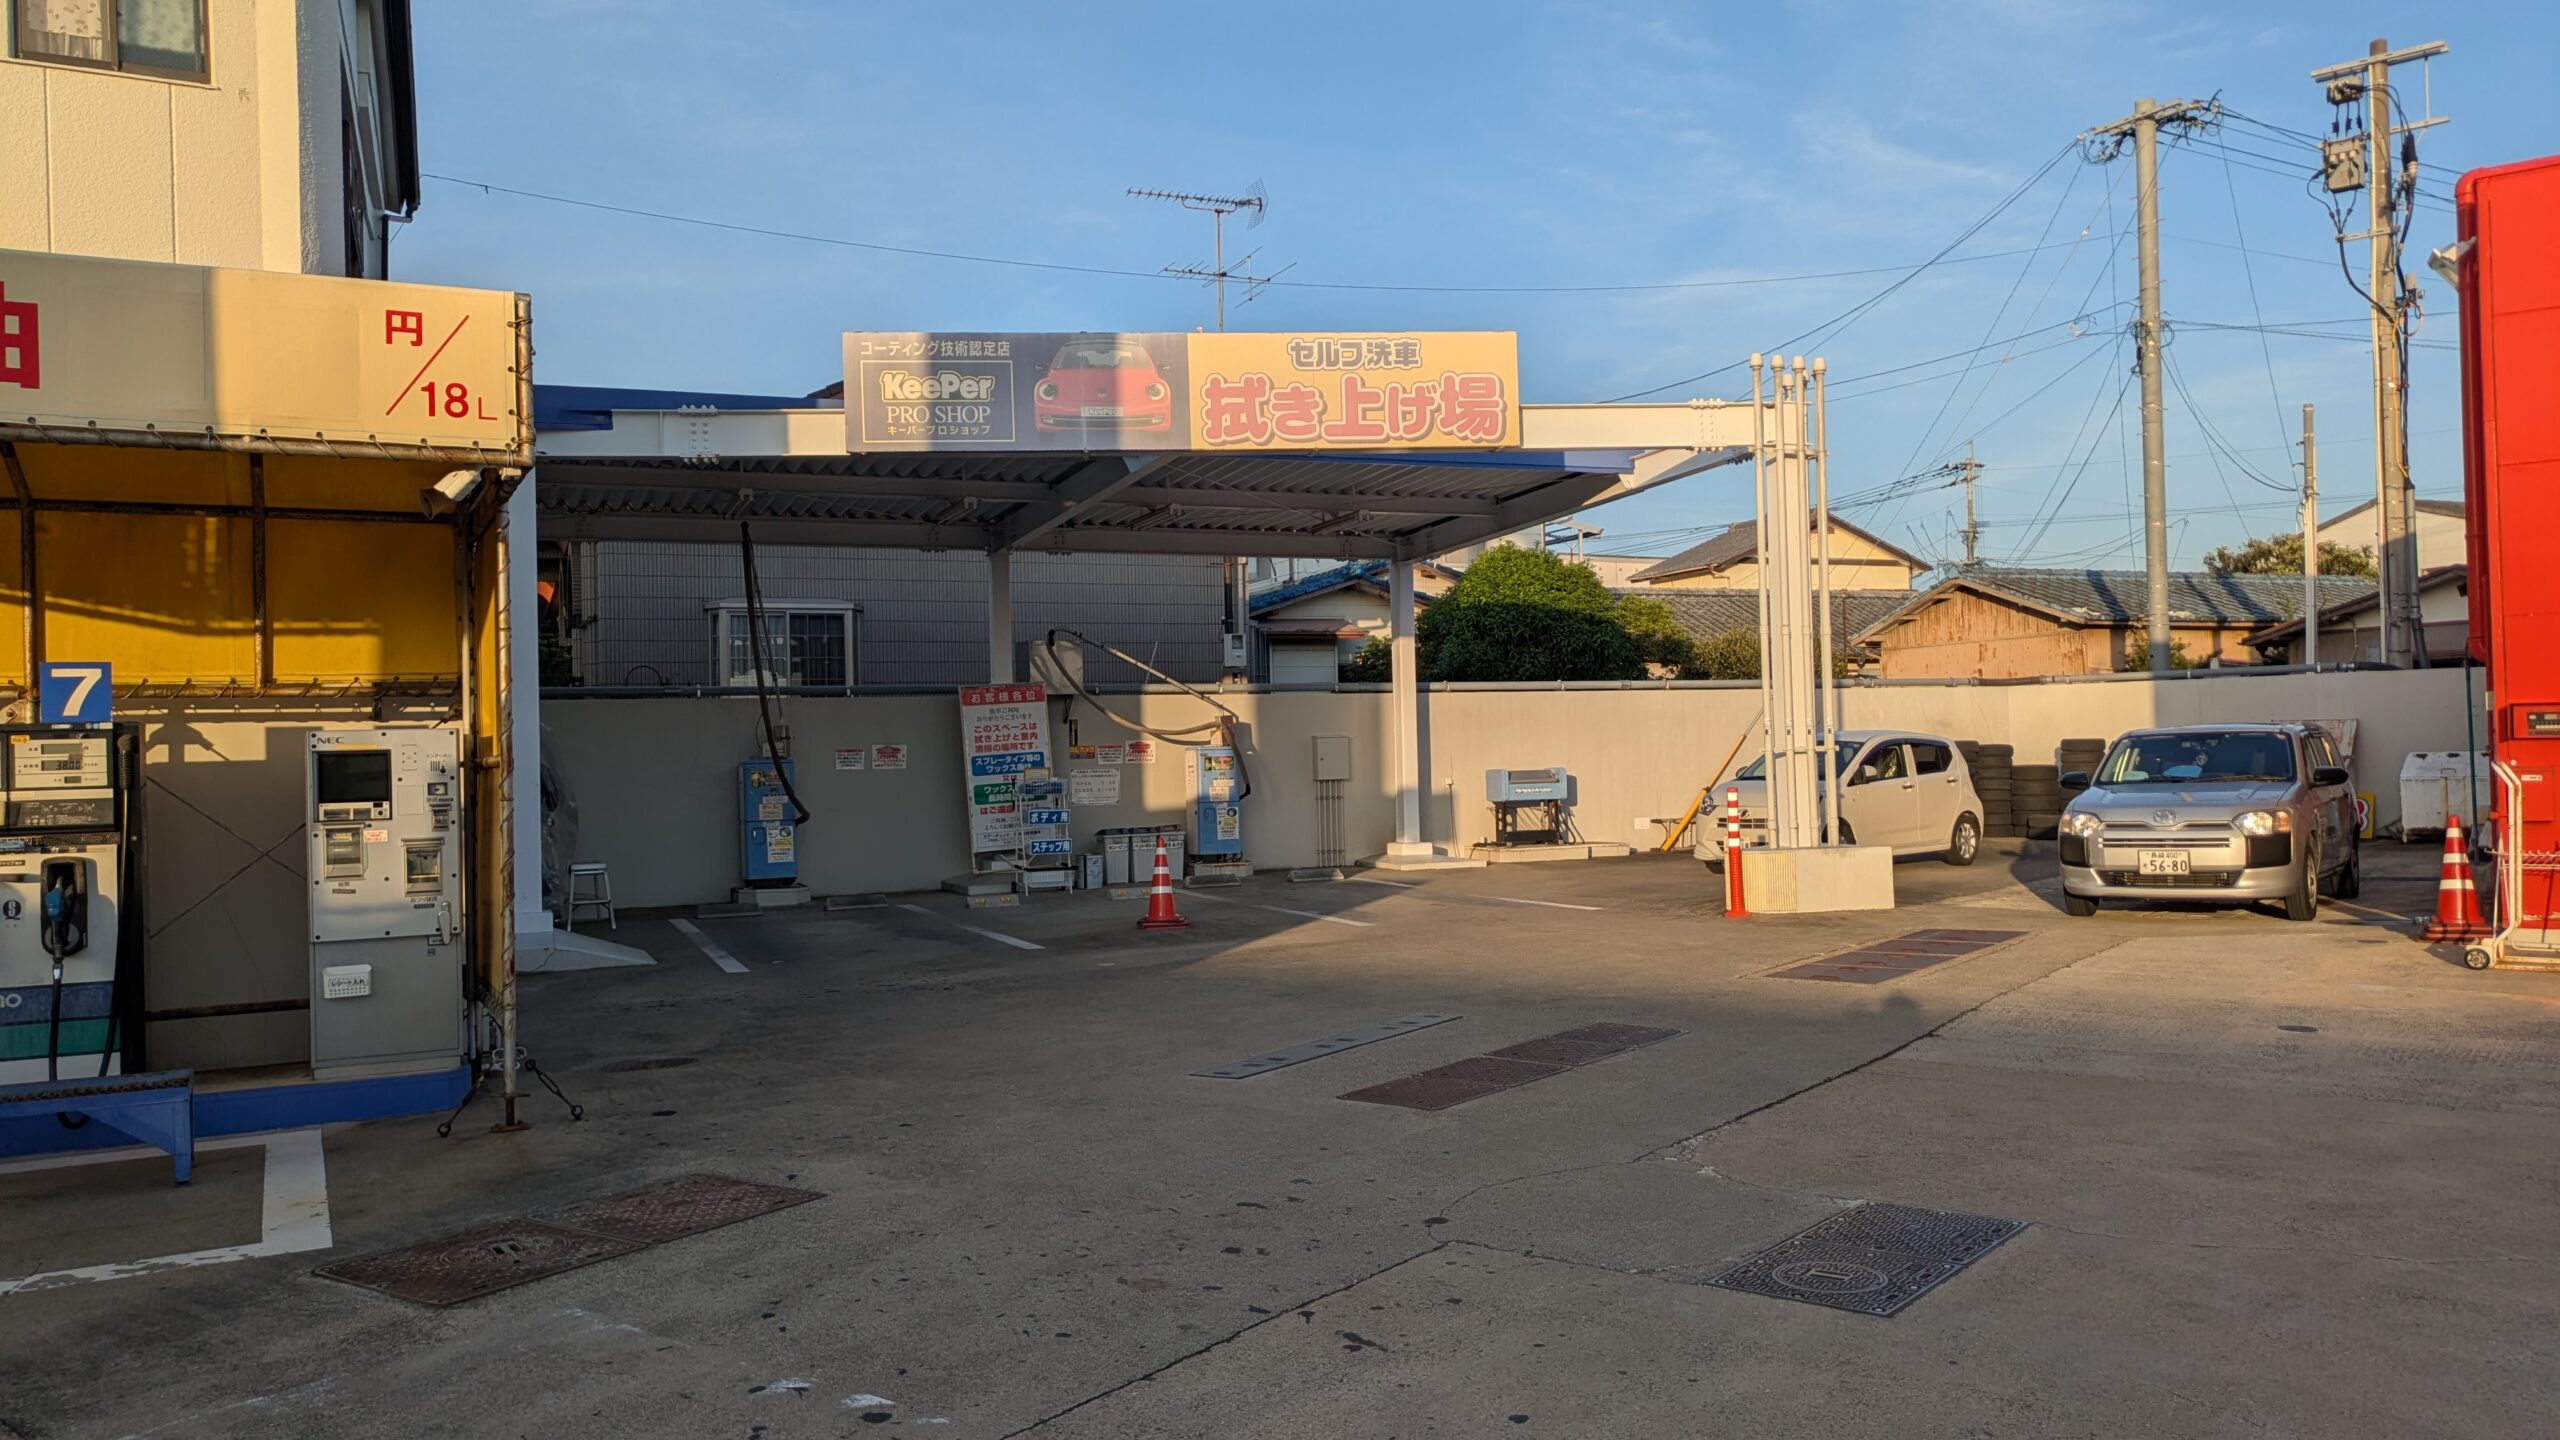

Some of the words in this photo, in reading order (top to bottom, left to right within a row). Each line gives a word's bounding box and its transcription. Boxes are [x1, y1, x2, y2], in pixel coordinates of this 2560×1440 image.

[860, 340, 1011, 357] コーティング技術認定店
[1288, 338, 1422, 369] セルフ洗車
[880, 371, 994, 401] KeePer
[1202, 373, 1506, 442] 拭き上げ場
[886, 405, 930, 424] PRO
[935, 405, 991, 424] SHOP
[887, 425, 991, 437] キーパープロショップ
[51, 668, 102, 717] 7
[971, 690, 1036, 704] お客様各位
[976, 713, 1032, 722] ありがとうございます
[974, 722, 1038, 734] このスペースは
[317, 736, 345, 744] NEC
[974, 732, 1038, 744] 拭き上げと室内
[975, 754, 1041, 766] スプレータイプ等の
[1031, 812, 1068, 823] ボディ用
[1033, 841, 1070, 853] ステップ用
[2150, 860, 2187, 872] 56-80
[330, 978, 367, 988] レシート入れ
